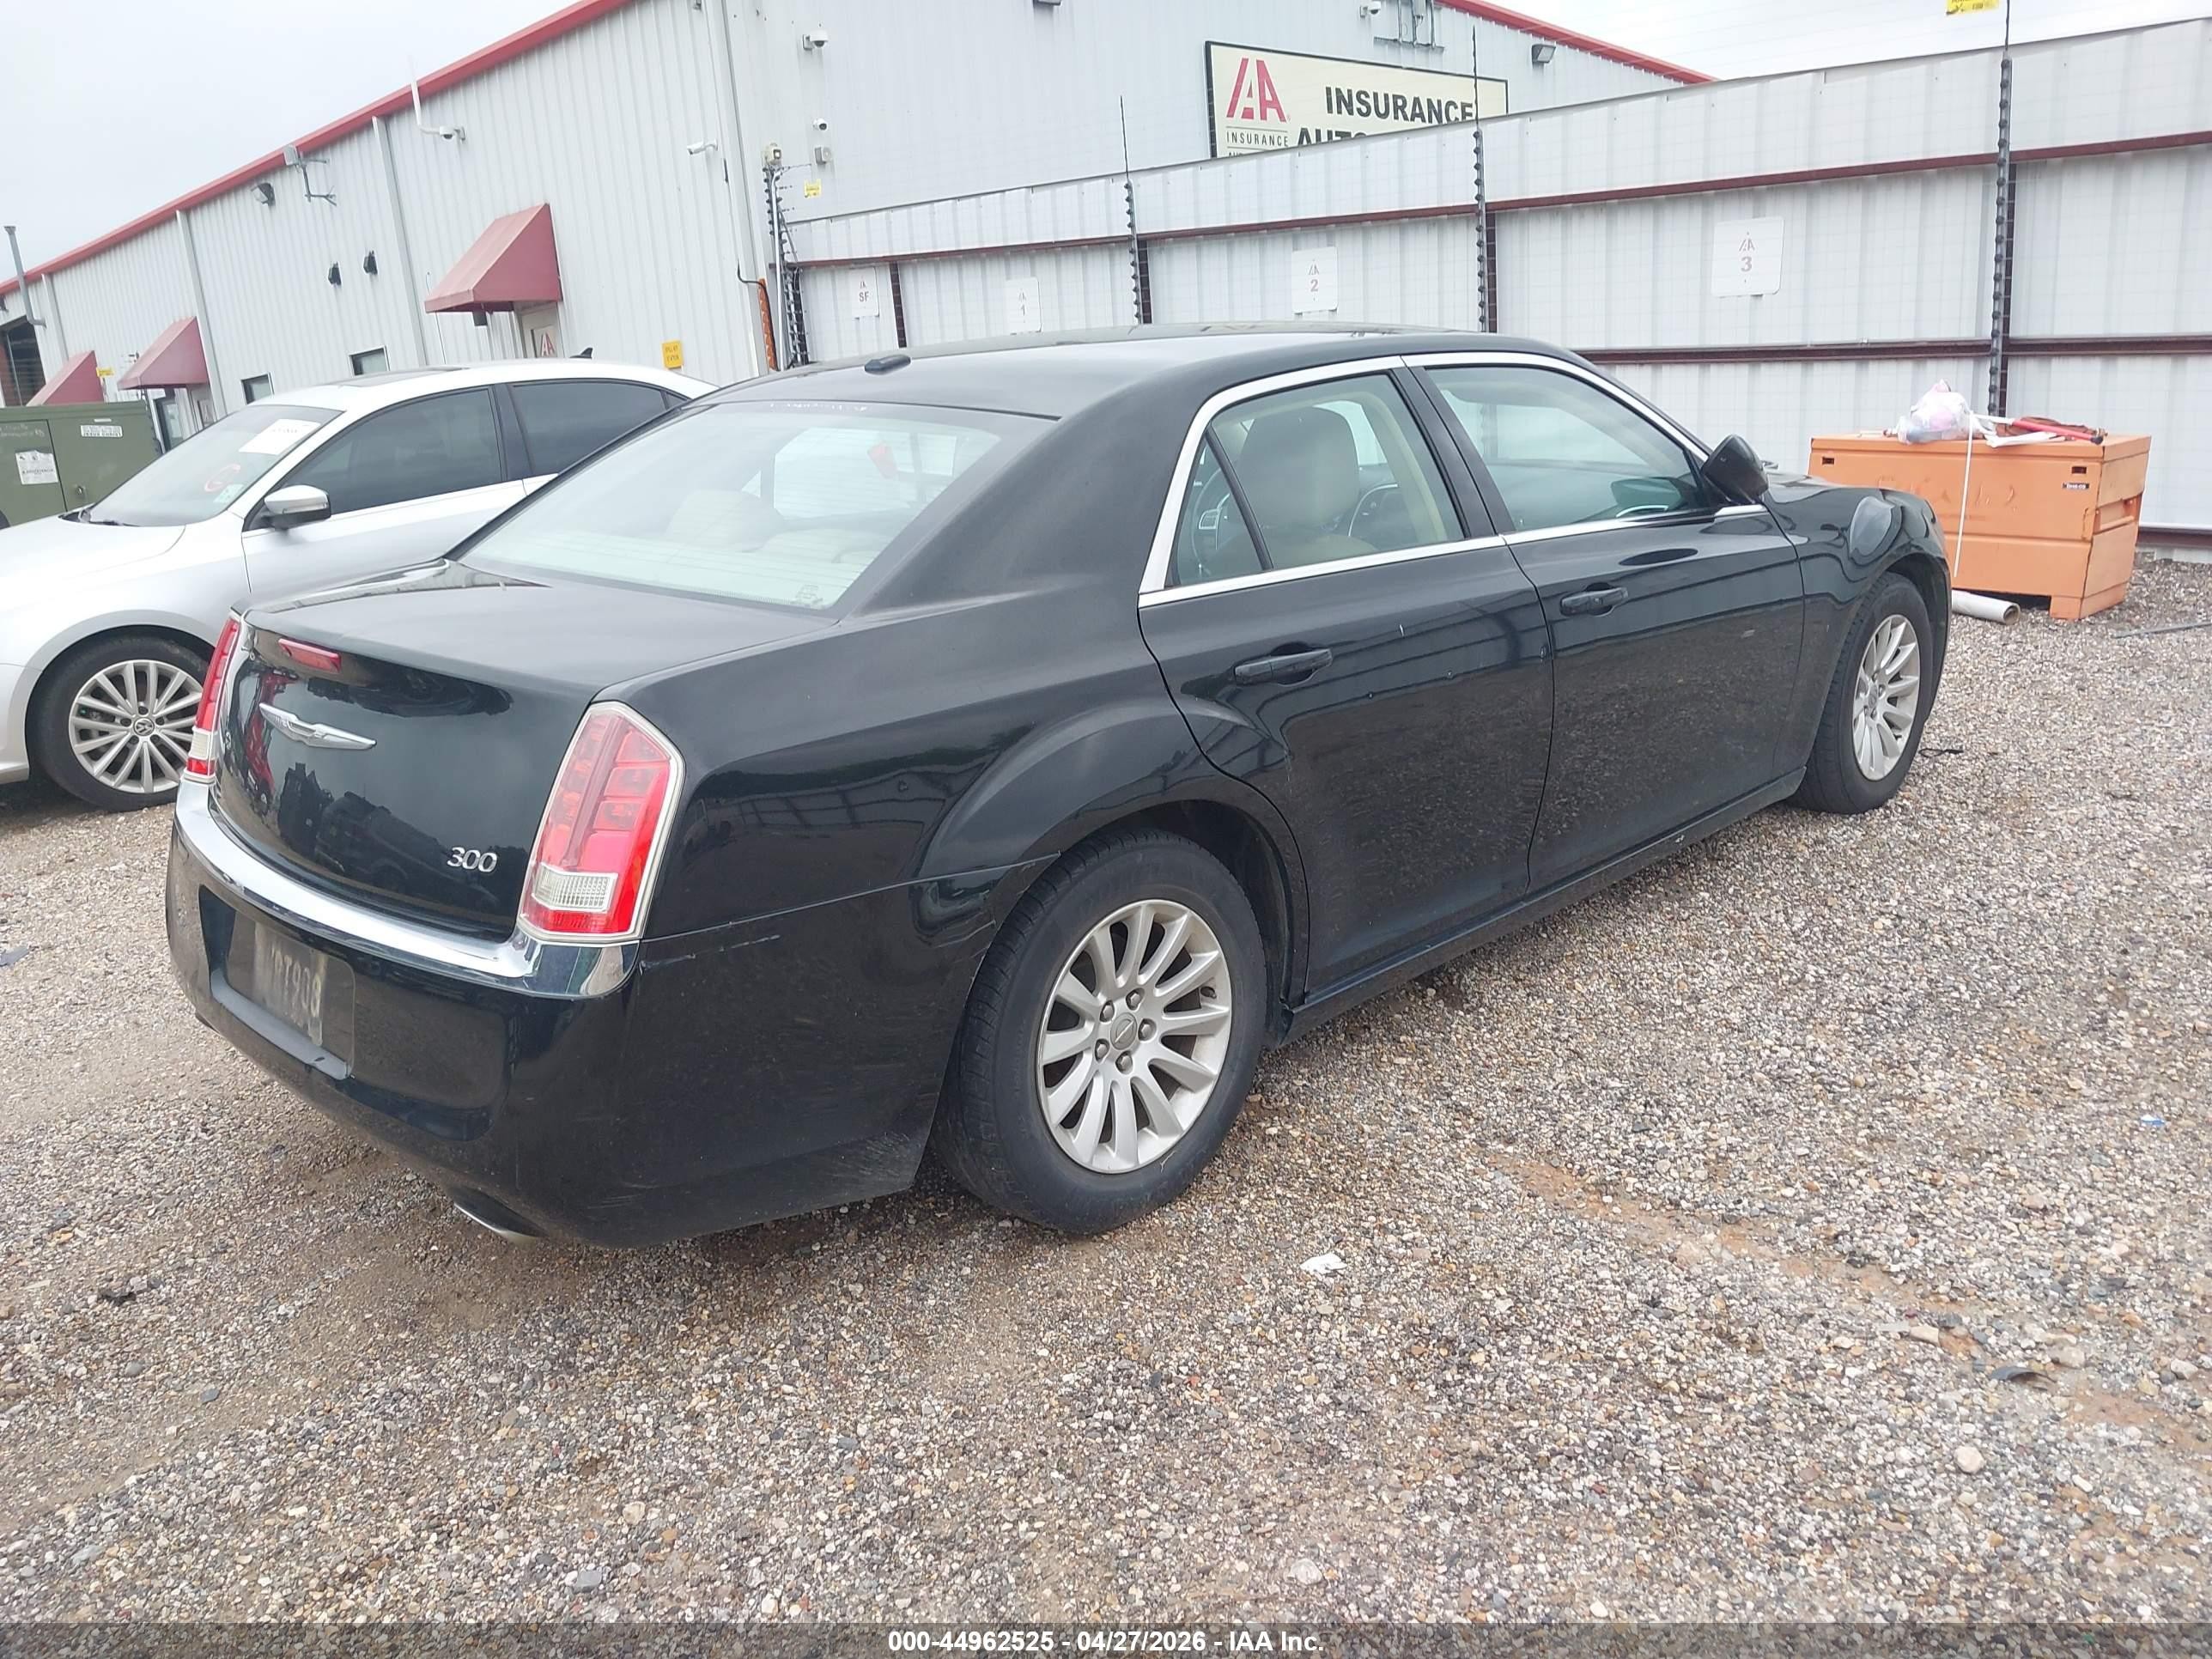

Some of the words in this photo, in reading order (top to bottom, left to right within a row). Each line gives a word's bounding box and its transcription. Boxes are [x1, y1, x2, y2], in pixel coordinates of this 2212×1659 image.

[1325, 86, 1474, 125] INSURANCE
[1226, 131, 1289, 147] INSURANCE
[1740, 256, 1753, 273] 3
[1310, 279, 1319, 292] 2
[859, 292, 869, 302] SF
[1020, 305, 1026, 316] 1
[447, 847, 498, 872] 300
